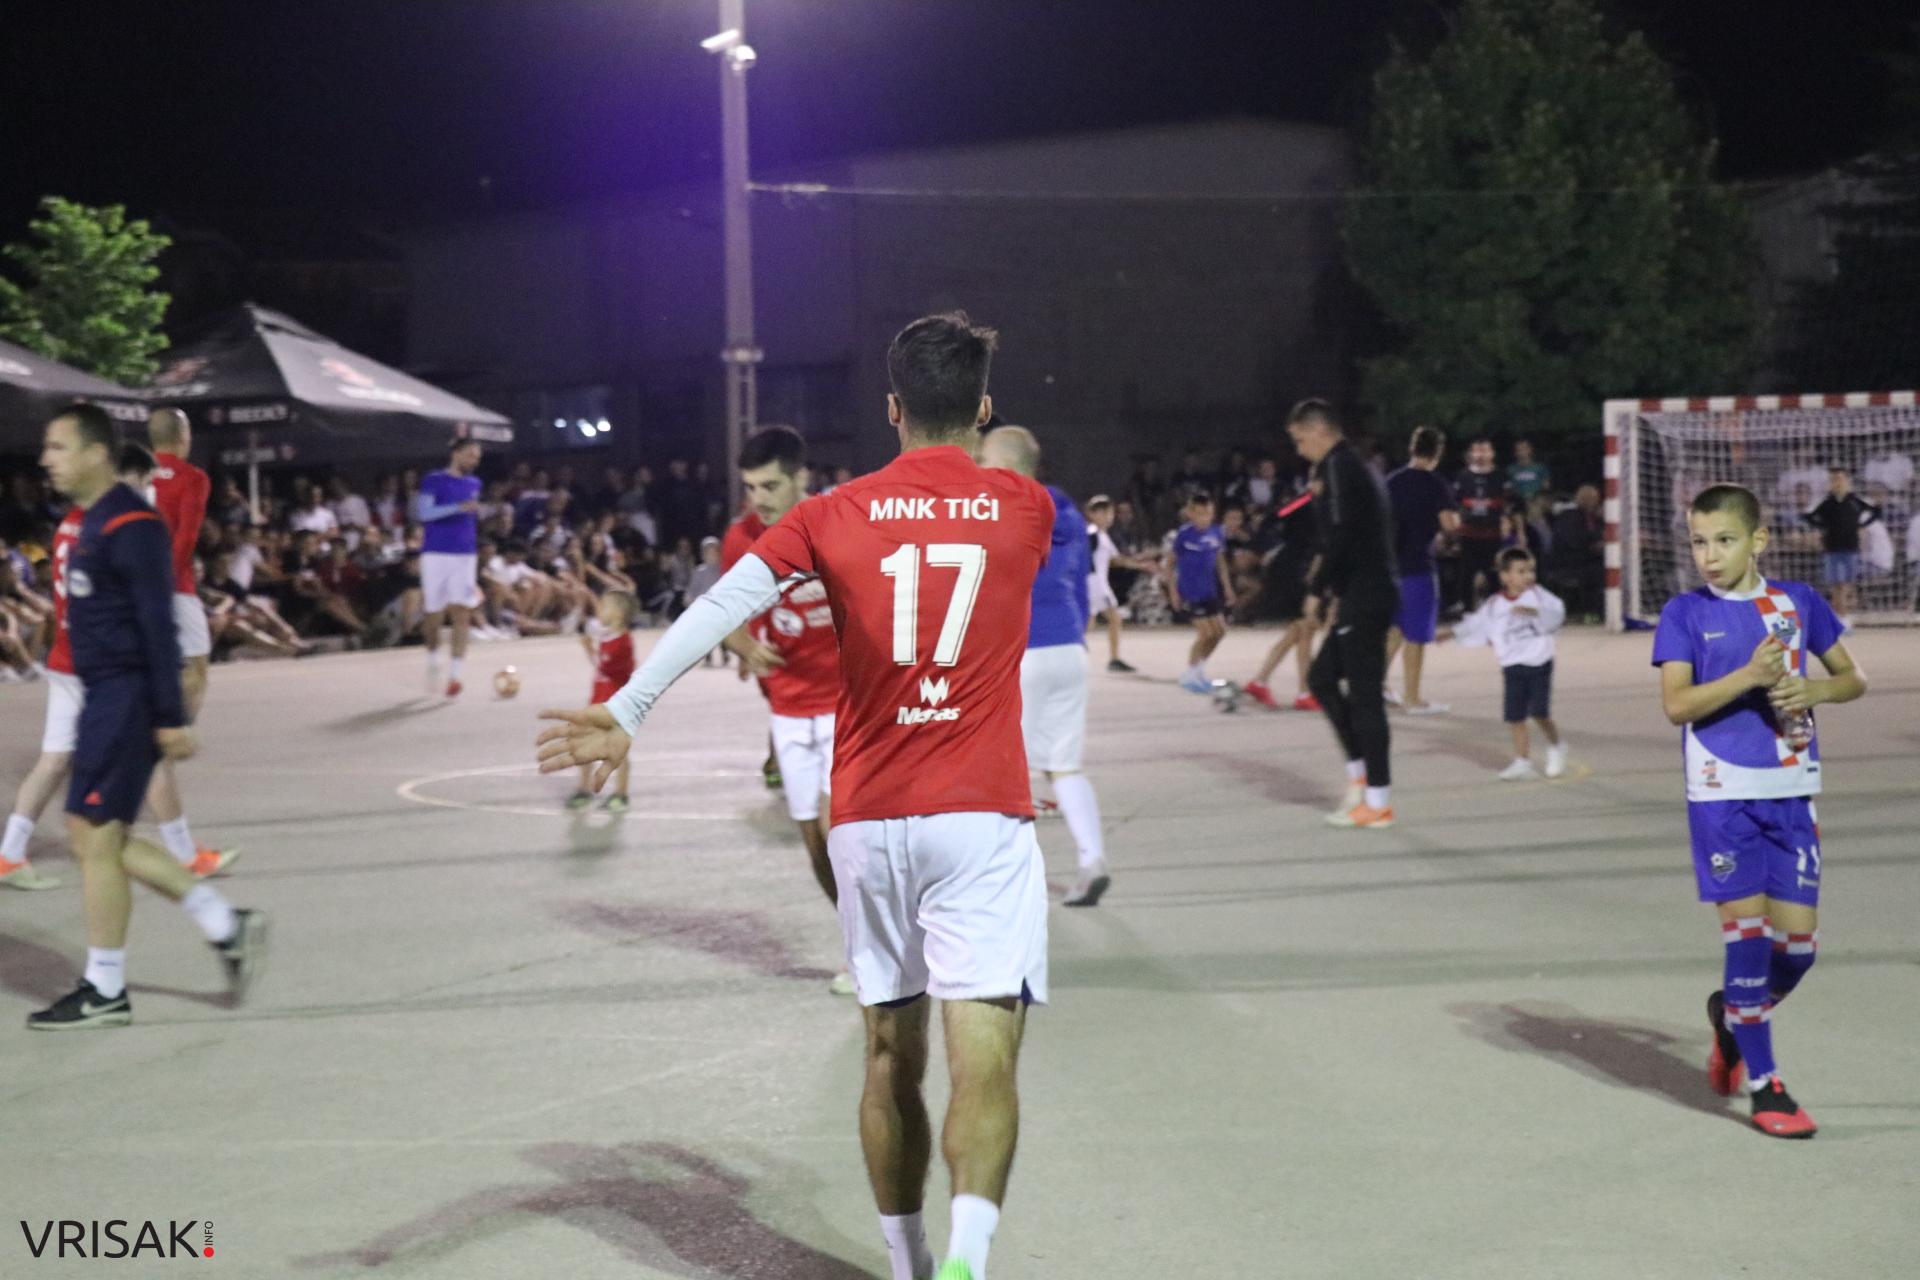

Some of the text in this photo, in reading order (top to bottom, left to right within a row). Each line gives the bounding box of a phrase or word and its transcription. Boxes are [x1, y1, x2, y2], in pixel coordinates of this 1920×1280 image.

[870, 493, 999, 522] MNK TIĆI
[880, 543, 987, 667] 17
